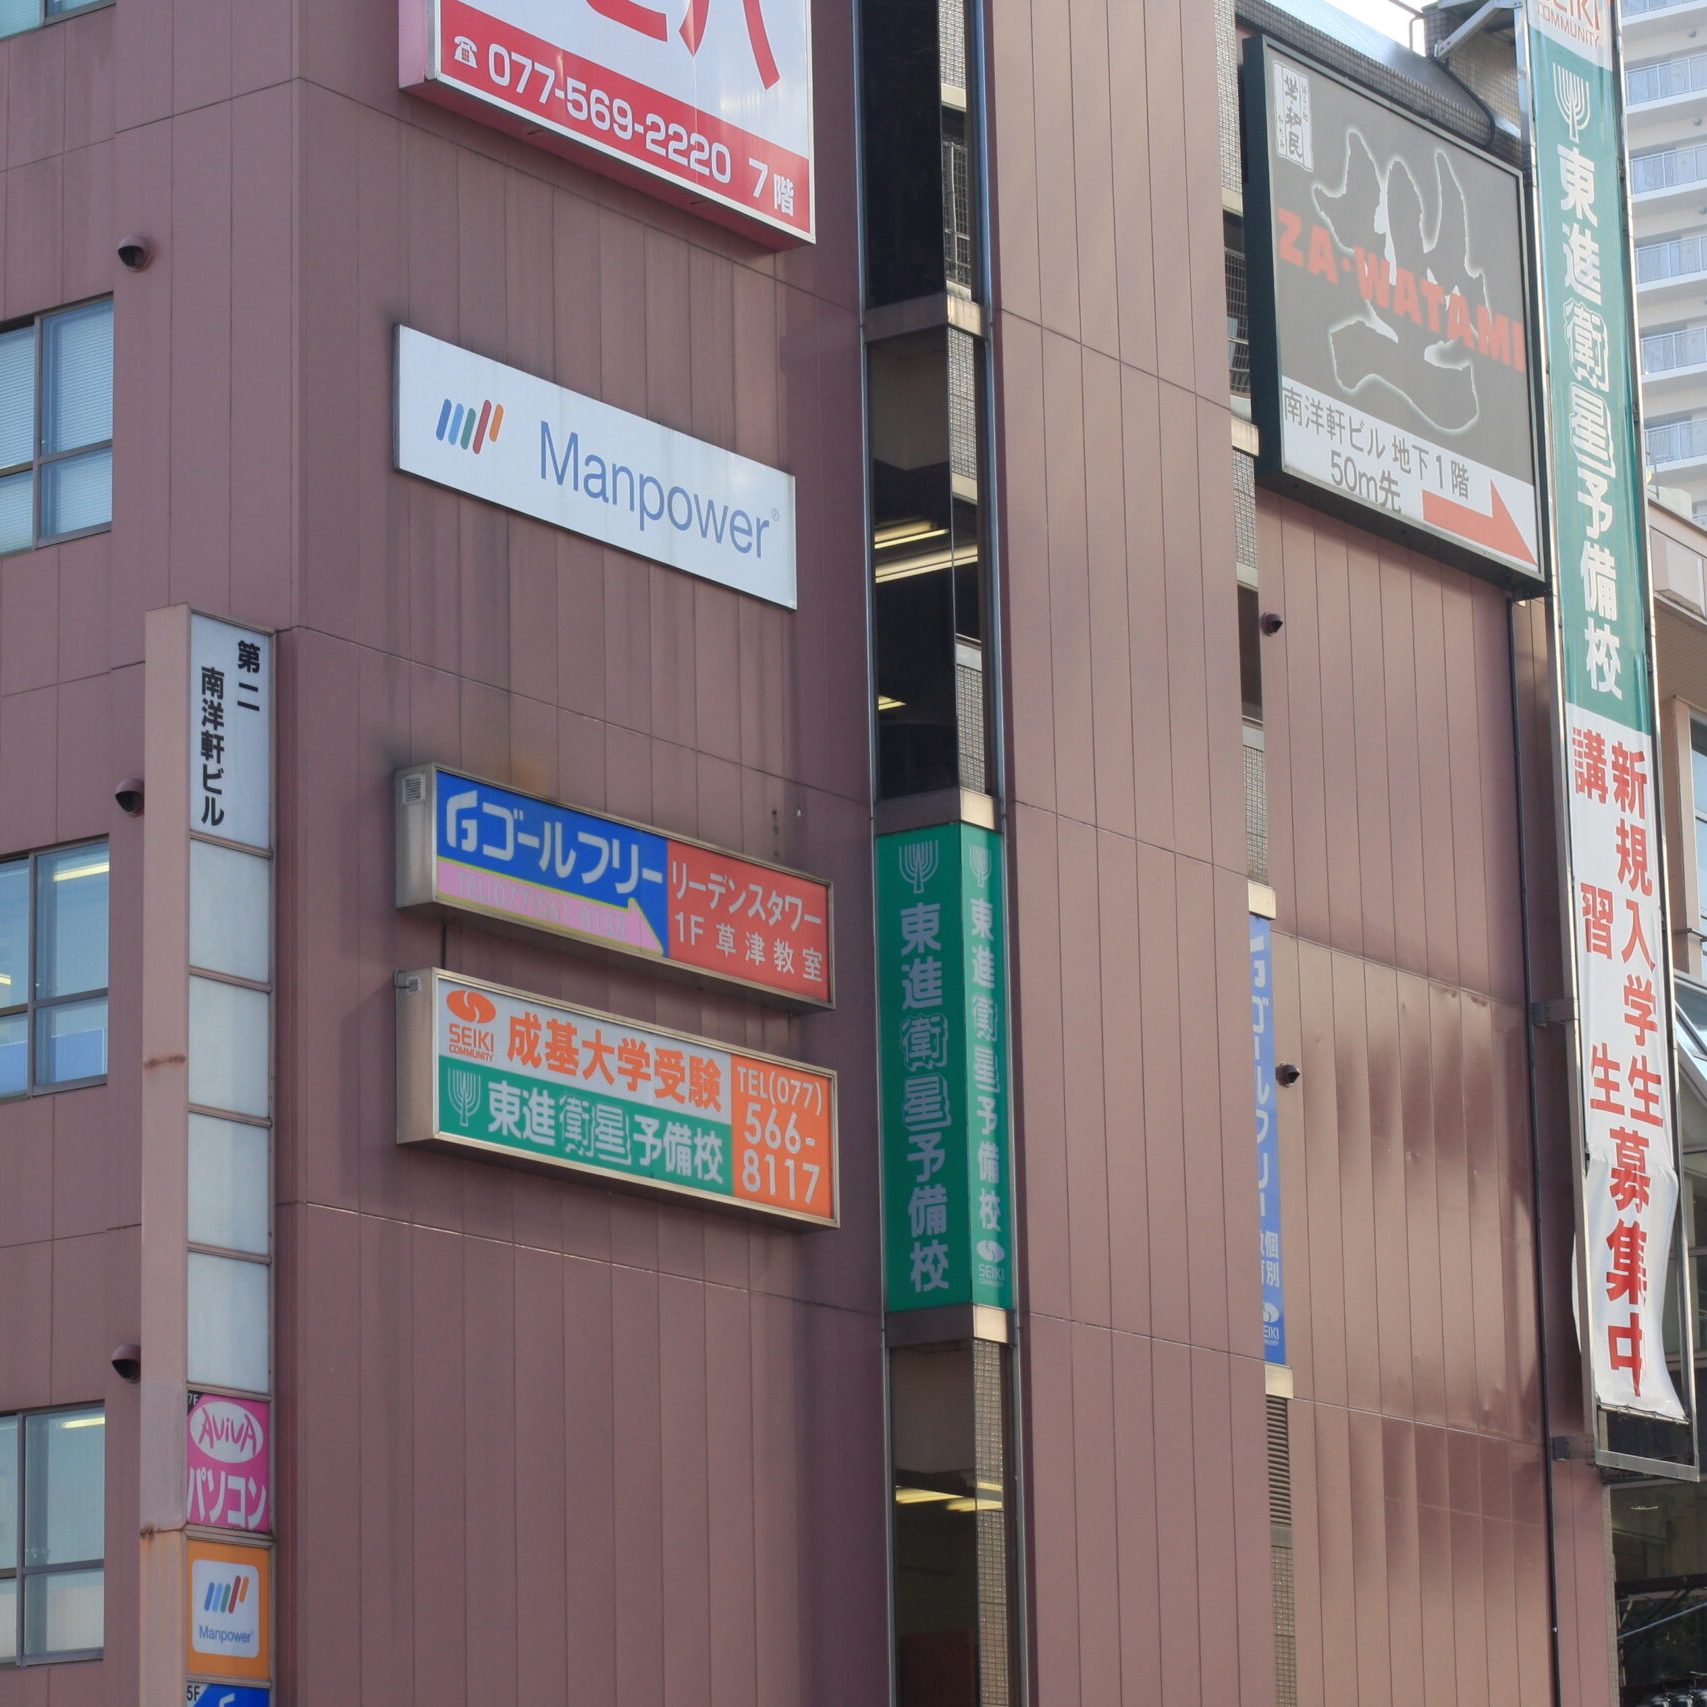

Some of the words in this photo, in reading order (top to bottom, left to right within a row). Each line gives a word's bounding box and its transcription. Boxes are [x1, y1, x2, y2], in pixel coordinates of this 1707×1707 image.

[488, 43, 731, 184] 077-569-2220
[748, 157, 795, 217] 7階
[1283, 386, 1386, 460] 南洋軒ビル
[1392, 435, 1470, 500] 地下1階
[1557, 144, 1623, 700] 東進衛星予備校
[540, 420, 770, 558] Manpower
[1330, 450, 1402, 514] 50m先
[237, 640, 261, 712] 第二
[200, 666, 225, 827] 南洋軒ビル
[672, 861, 822, 932] リーデンスタワー
[675, 912, 704, 946] 1F
[716, 922, 823, 983] 草津教室
[448, 1023, 494, 1052] SEIKI
[449, 1043, 494, 1062] COMMUNITY
[507, 1012, 722, 1112] 成基大学受験
[737, 1066, 823, 1116] TEL(077)
[900, 902, 951, 1293] 東進衛星予備校
[487, 1081, 724, 1184] 東進衛星予備校
[744, 1104, 816, 1154] 566-
[742, 1151, 821, 1204] 8117
[1263, 1324, 1280, 1341] EIKI
[187, 1467, 267, 1530] パソコン
[199, 1625, 252, 1644] Manpower
[186, 1685, 200, 1701] 5F
